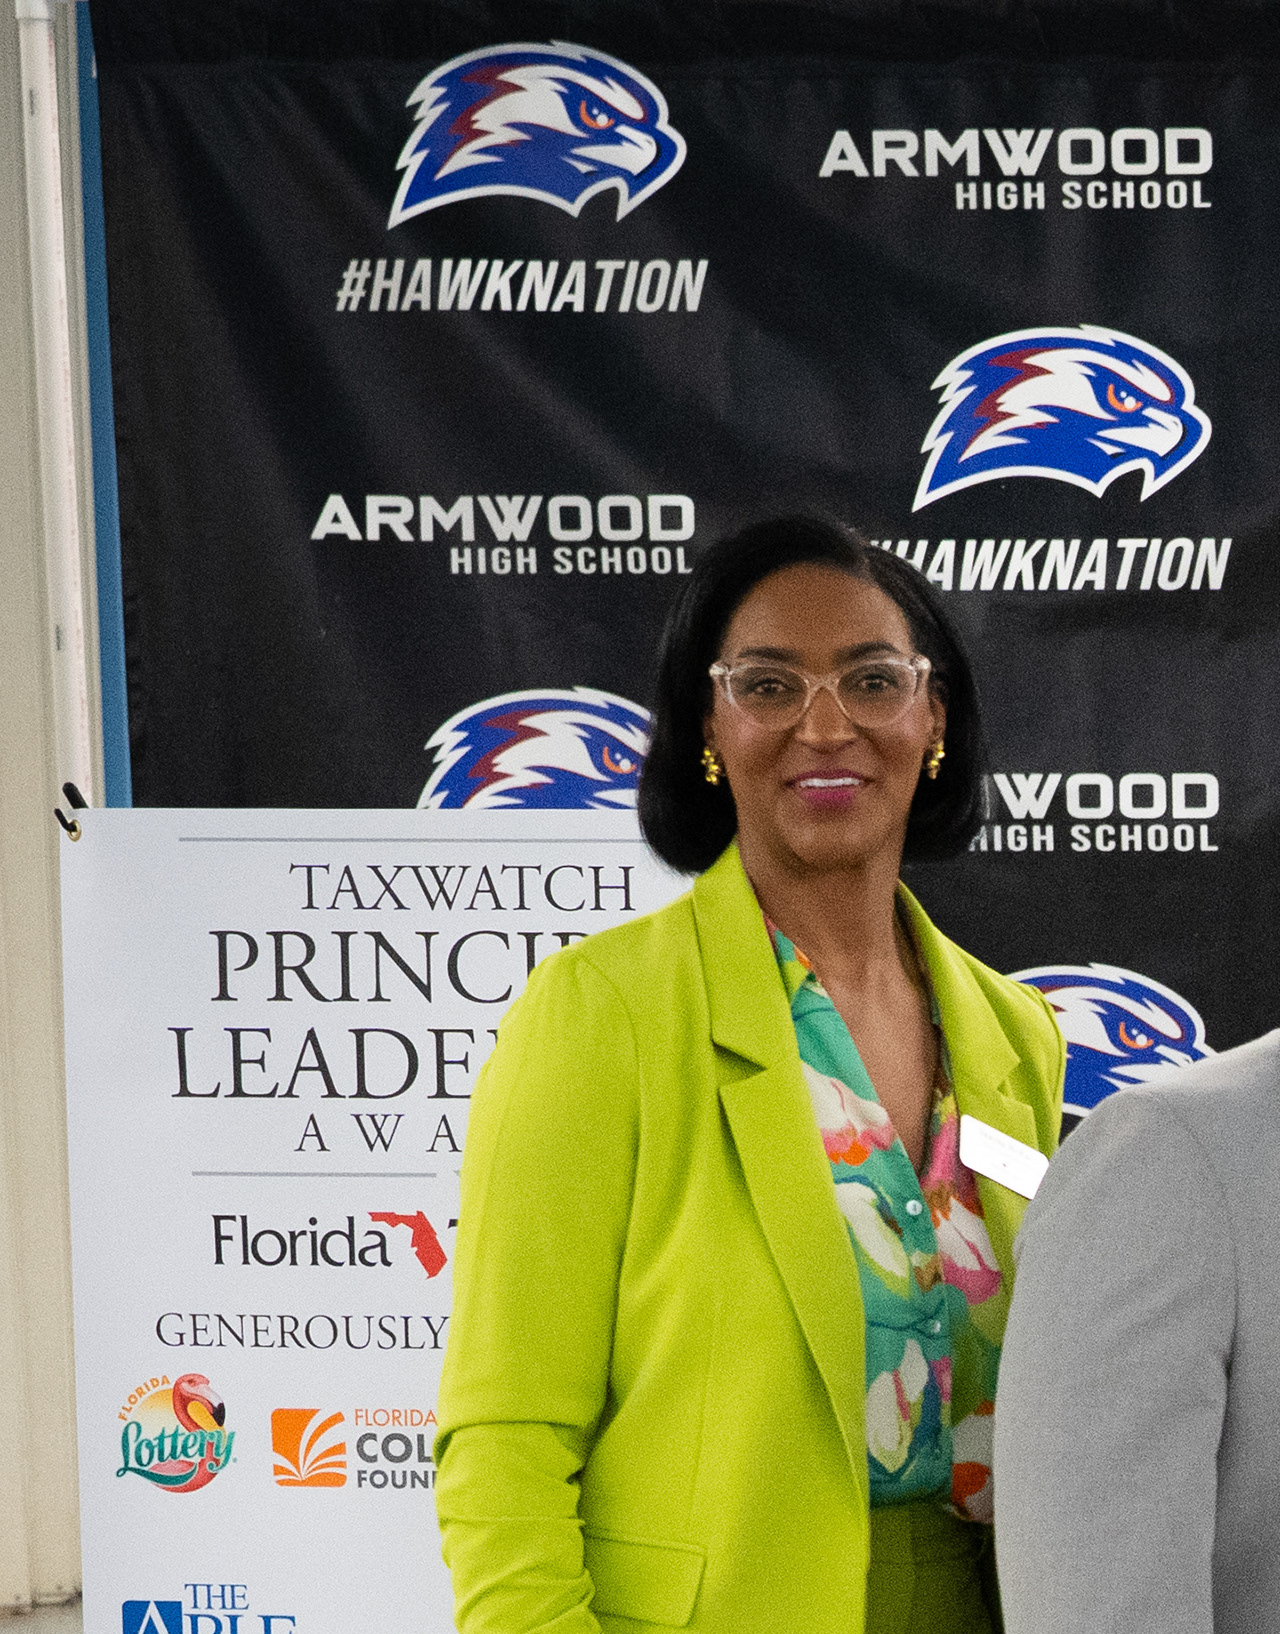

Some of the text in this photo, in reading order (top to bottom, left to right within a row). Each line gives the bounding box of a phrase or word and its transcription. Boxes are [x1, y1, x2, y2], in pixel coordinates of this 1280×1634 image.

[820, 129, 1212, 176] ARMWOOD
[956, 181, 1210, 209] HIGH SCHOOL
[338, 260, 707, 312] #HAWKNATION
[312, 495, 694, 540] ARMWOOD
[451, 548, 690, 573] HIGH SCHOOL
[869, 537, 1233, 592] HAWKNATION
[993, 772, 1219, 819] WOOD
[1071, 824, 1218, 851] SCHOOL
[289, 862, 637, 912] TAXWATCH
[209, 930, 592, 1004] PRINCI
[167, 1027, 499, 1100] LEADE
[211, 1214, 393, 1268] Florida
[155, 1312, 450, 1351] GENEROUSLY
[117, 1374, 172, 1421] FLORIDA
[355, 1408, 438, 1427] FLORIDA
[116, 1421, 236, 1486] Lottery
[184, 1583, 250, 1611] THE
